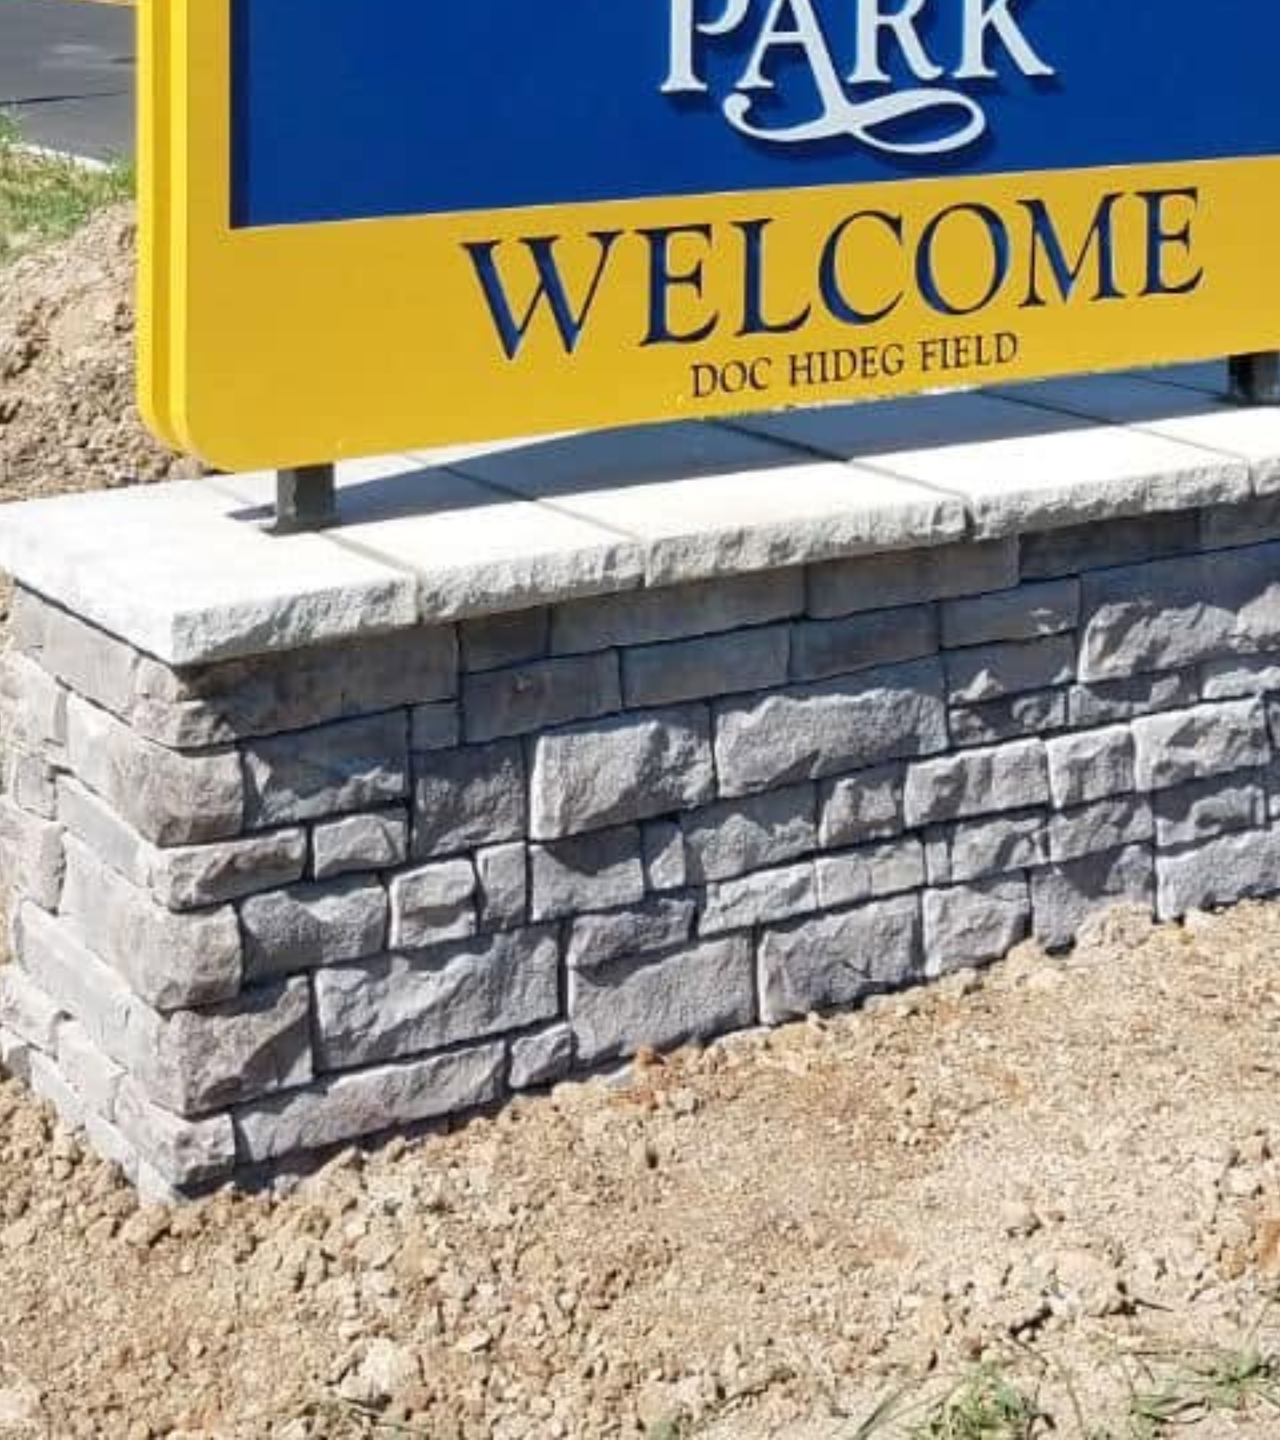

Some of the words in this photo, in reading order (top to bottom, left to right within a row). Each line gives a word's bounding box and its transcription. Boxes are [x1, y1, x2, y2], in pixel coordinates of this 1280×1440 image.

[461, 186, 1204, 361] WELCOME
[692, 356, 773, 399] DOC
[788, 343, 906, 388] HIDEG
[919, 332, 1019, 371] FIELD
